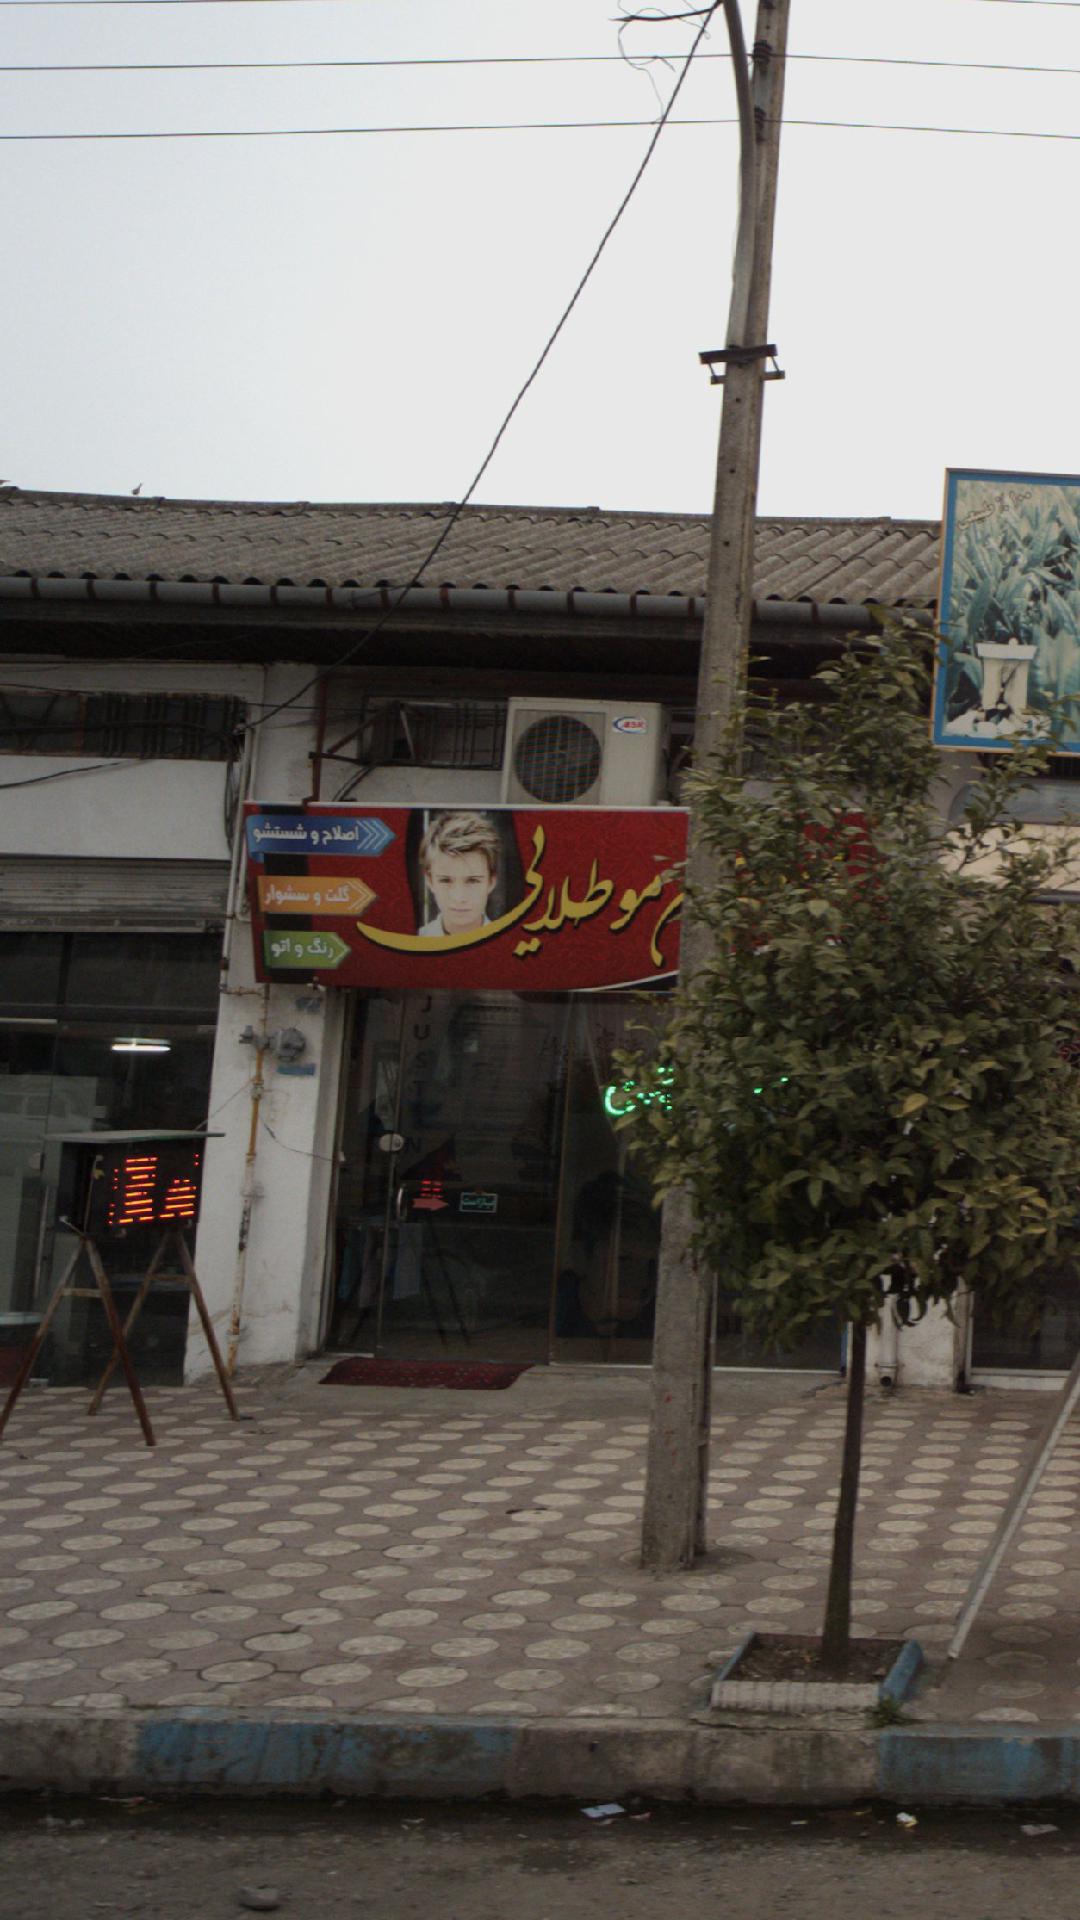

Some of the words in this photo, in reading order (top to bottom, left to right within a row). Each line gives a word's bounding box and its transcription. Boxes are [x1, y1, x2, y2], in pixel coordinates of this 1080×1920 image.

[253, 823, 307, 842] شستشو
[310, 830, 320, 845] و
[322, 825, 359, 845] اصلاح
[264, 884, 309, 905] سشوار
[313, 892, 321, 906] و
[294, 943, 303, 958] و
[307, 937, 334, 958] رنگ
